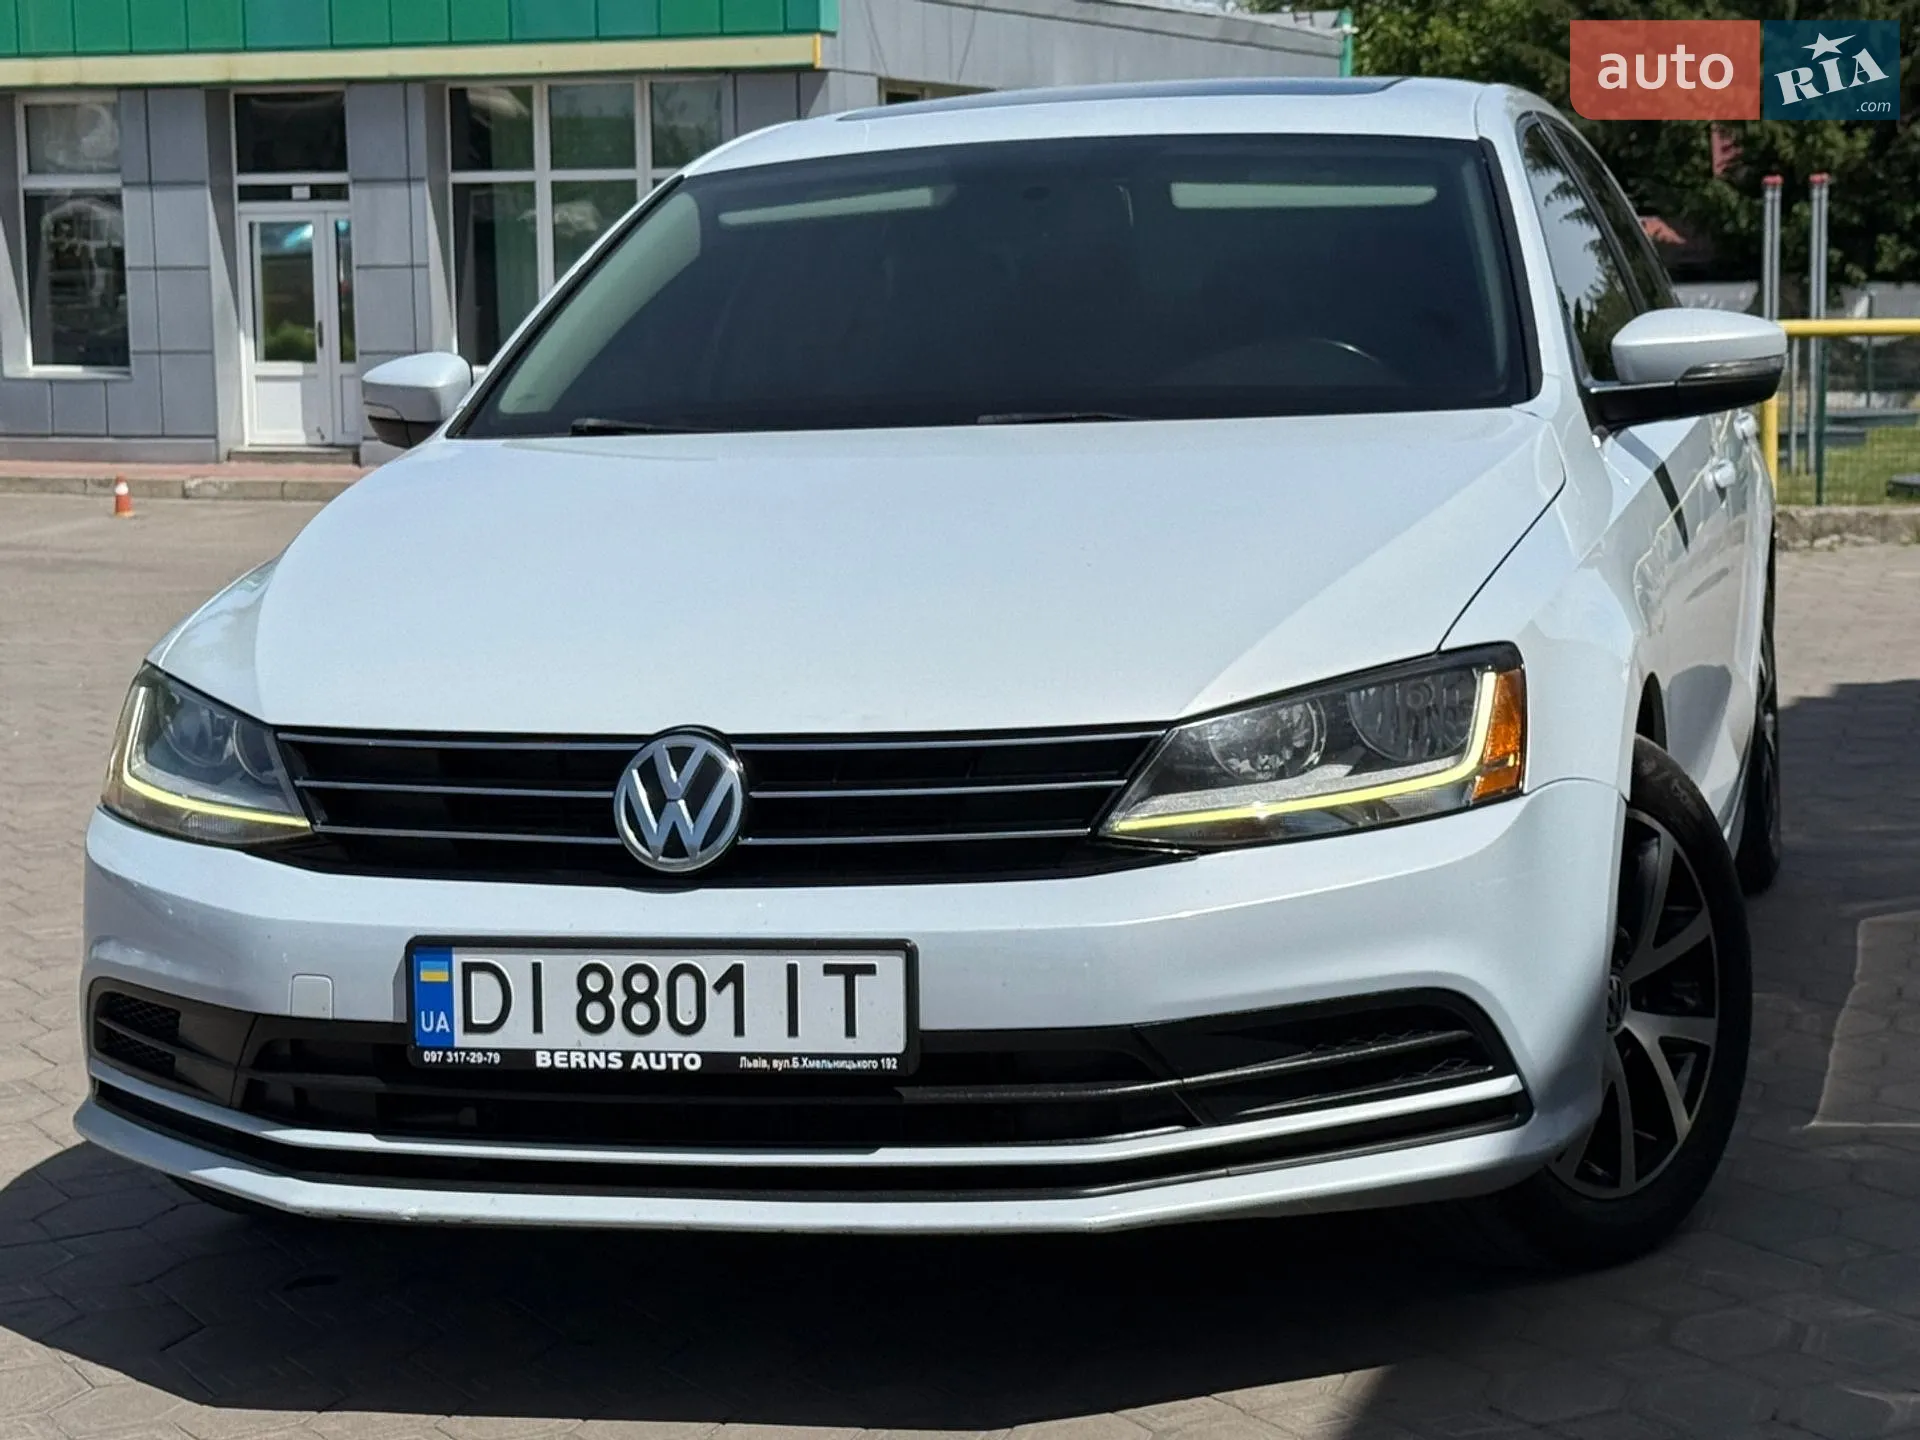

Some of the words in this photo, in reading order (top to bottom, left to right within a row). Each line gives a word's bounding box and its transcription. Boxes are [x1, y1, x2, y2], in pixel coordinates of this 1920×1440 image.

[461, 961, 543, 1035] DI
[575, 961, 746, 1037] 8801
[786, 962, 878, 1038] IT
[421, 1010, 450, 1033] UA
[423, 1051, 443, 1063] 097
[535, 1051, 624, 1069] BERNS
[630, 1052, 702, 1071] AUTO
[880, 1057, 898, 1070] 192
